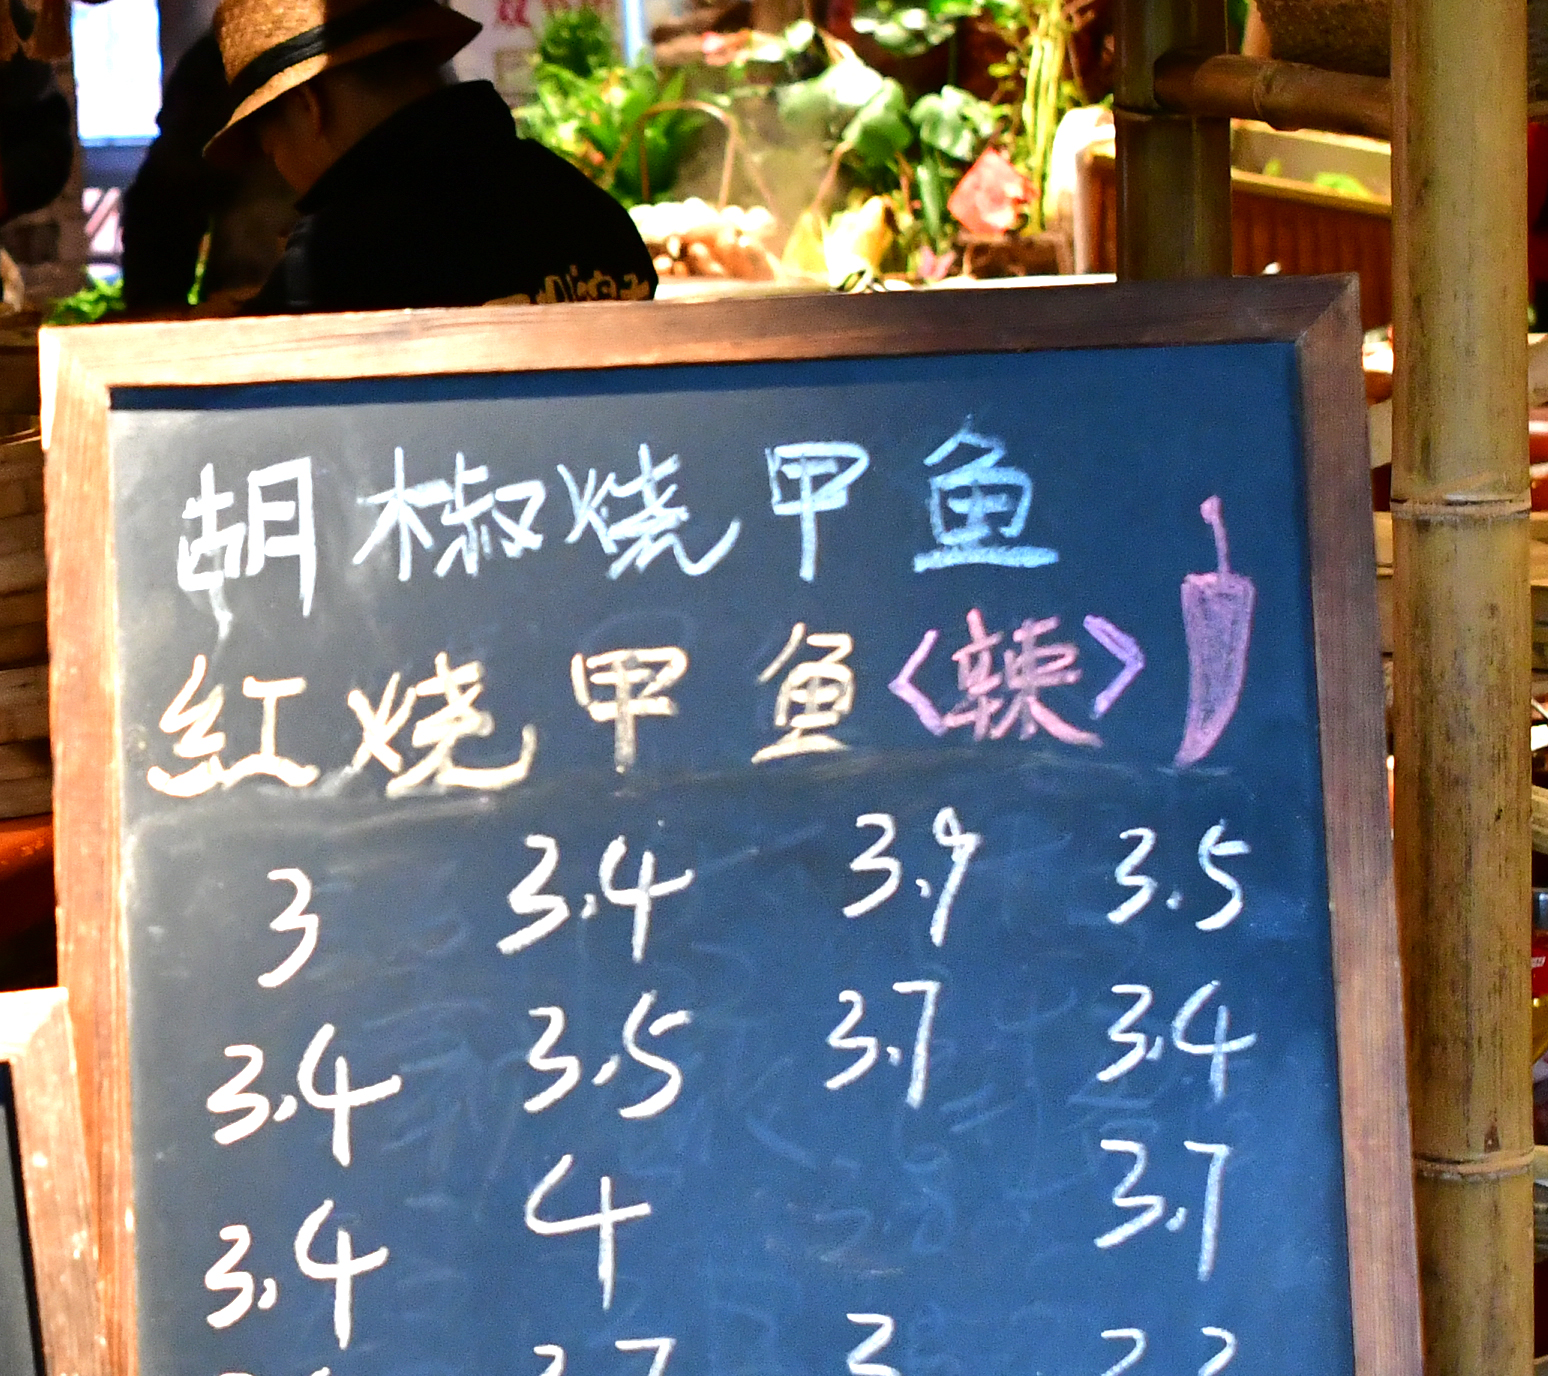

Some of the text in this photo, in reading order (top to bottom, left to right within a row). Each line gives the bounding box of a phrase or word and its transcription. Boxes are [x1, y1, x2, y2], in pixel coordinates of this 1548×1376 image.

[177, 414, 1059, 617] 胡椒烧甲鱼
[258, 868, 319, 987] 3
[498, 834, 694, 960] 3.4
[1107, 825, 1248, 931] 3.5
[206, 980, 1255, 1166] 3.4 3.5 3.7 3.4
[204, 1139, 1230, 1349] 3.4 4 3.7
